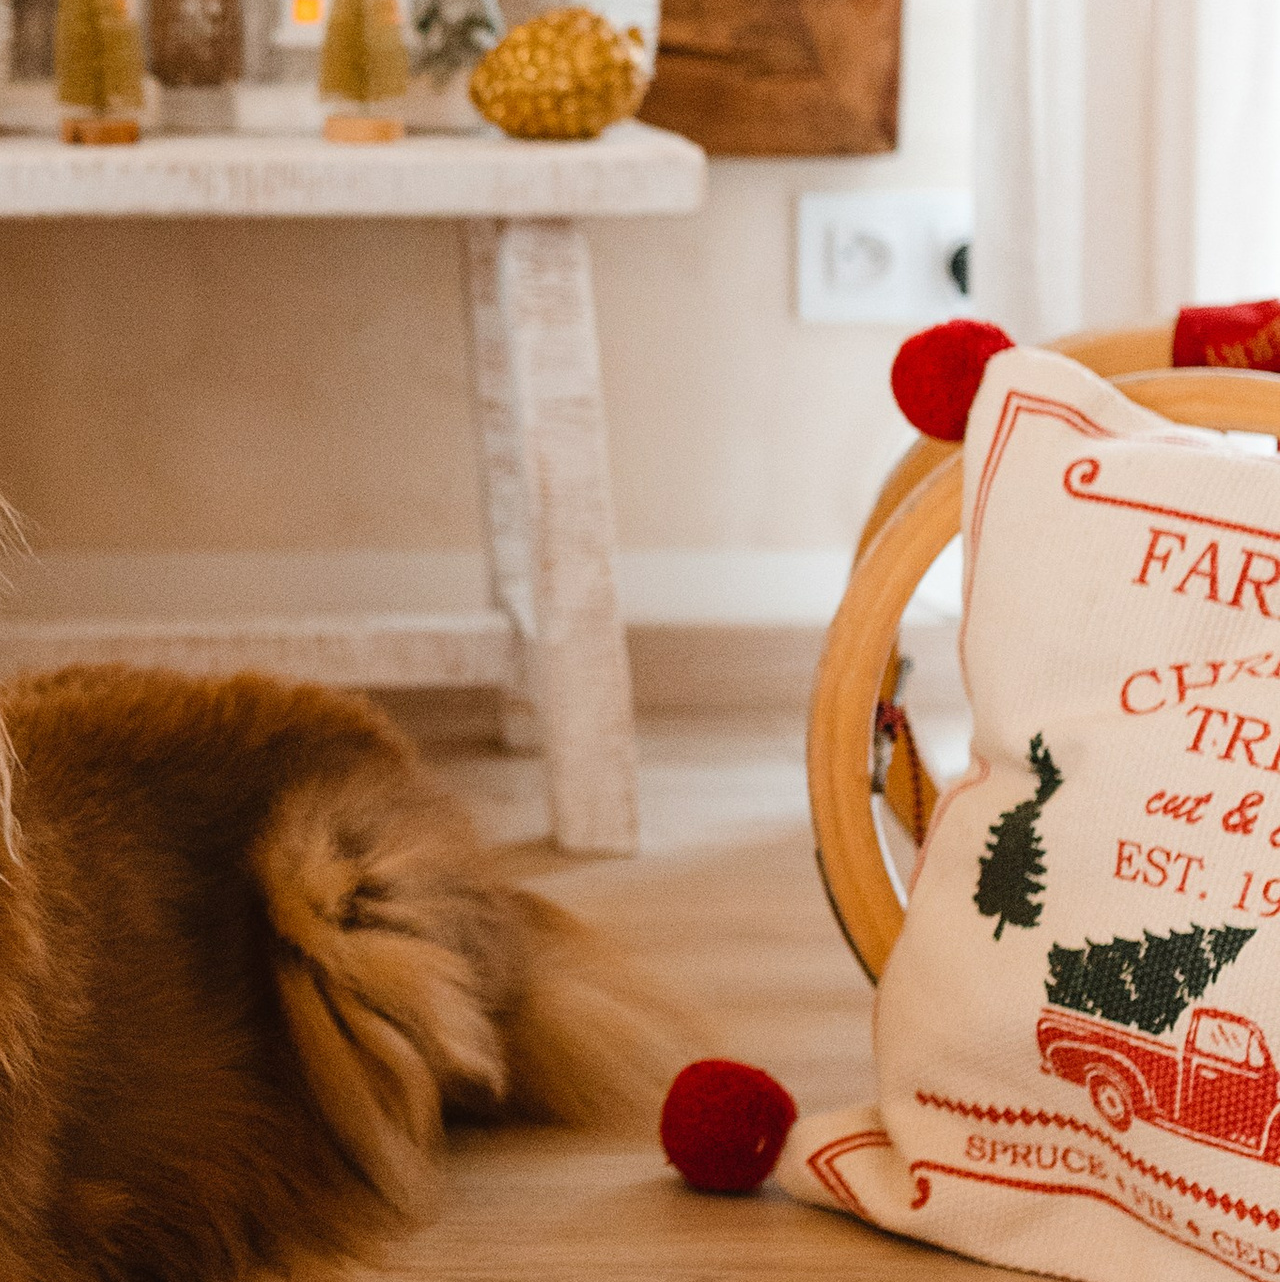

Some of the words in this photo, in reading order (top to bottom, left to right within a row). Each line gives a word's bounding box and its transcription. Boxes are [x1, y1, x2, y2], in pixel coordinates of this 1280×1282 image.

[1131, 526, 1280, 619] FAR
[1120, 651, 1280, 714] CHR
[1145, 789, 1213, 824] cut
[1221, 790, 1264, 836] &
[1115, 839, 1207, 901] EST.
[965, 1133, 1109, 1181] SPRUCE
